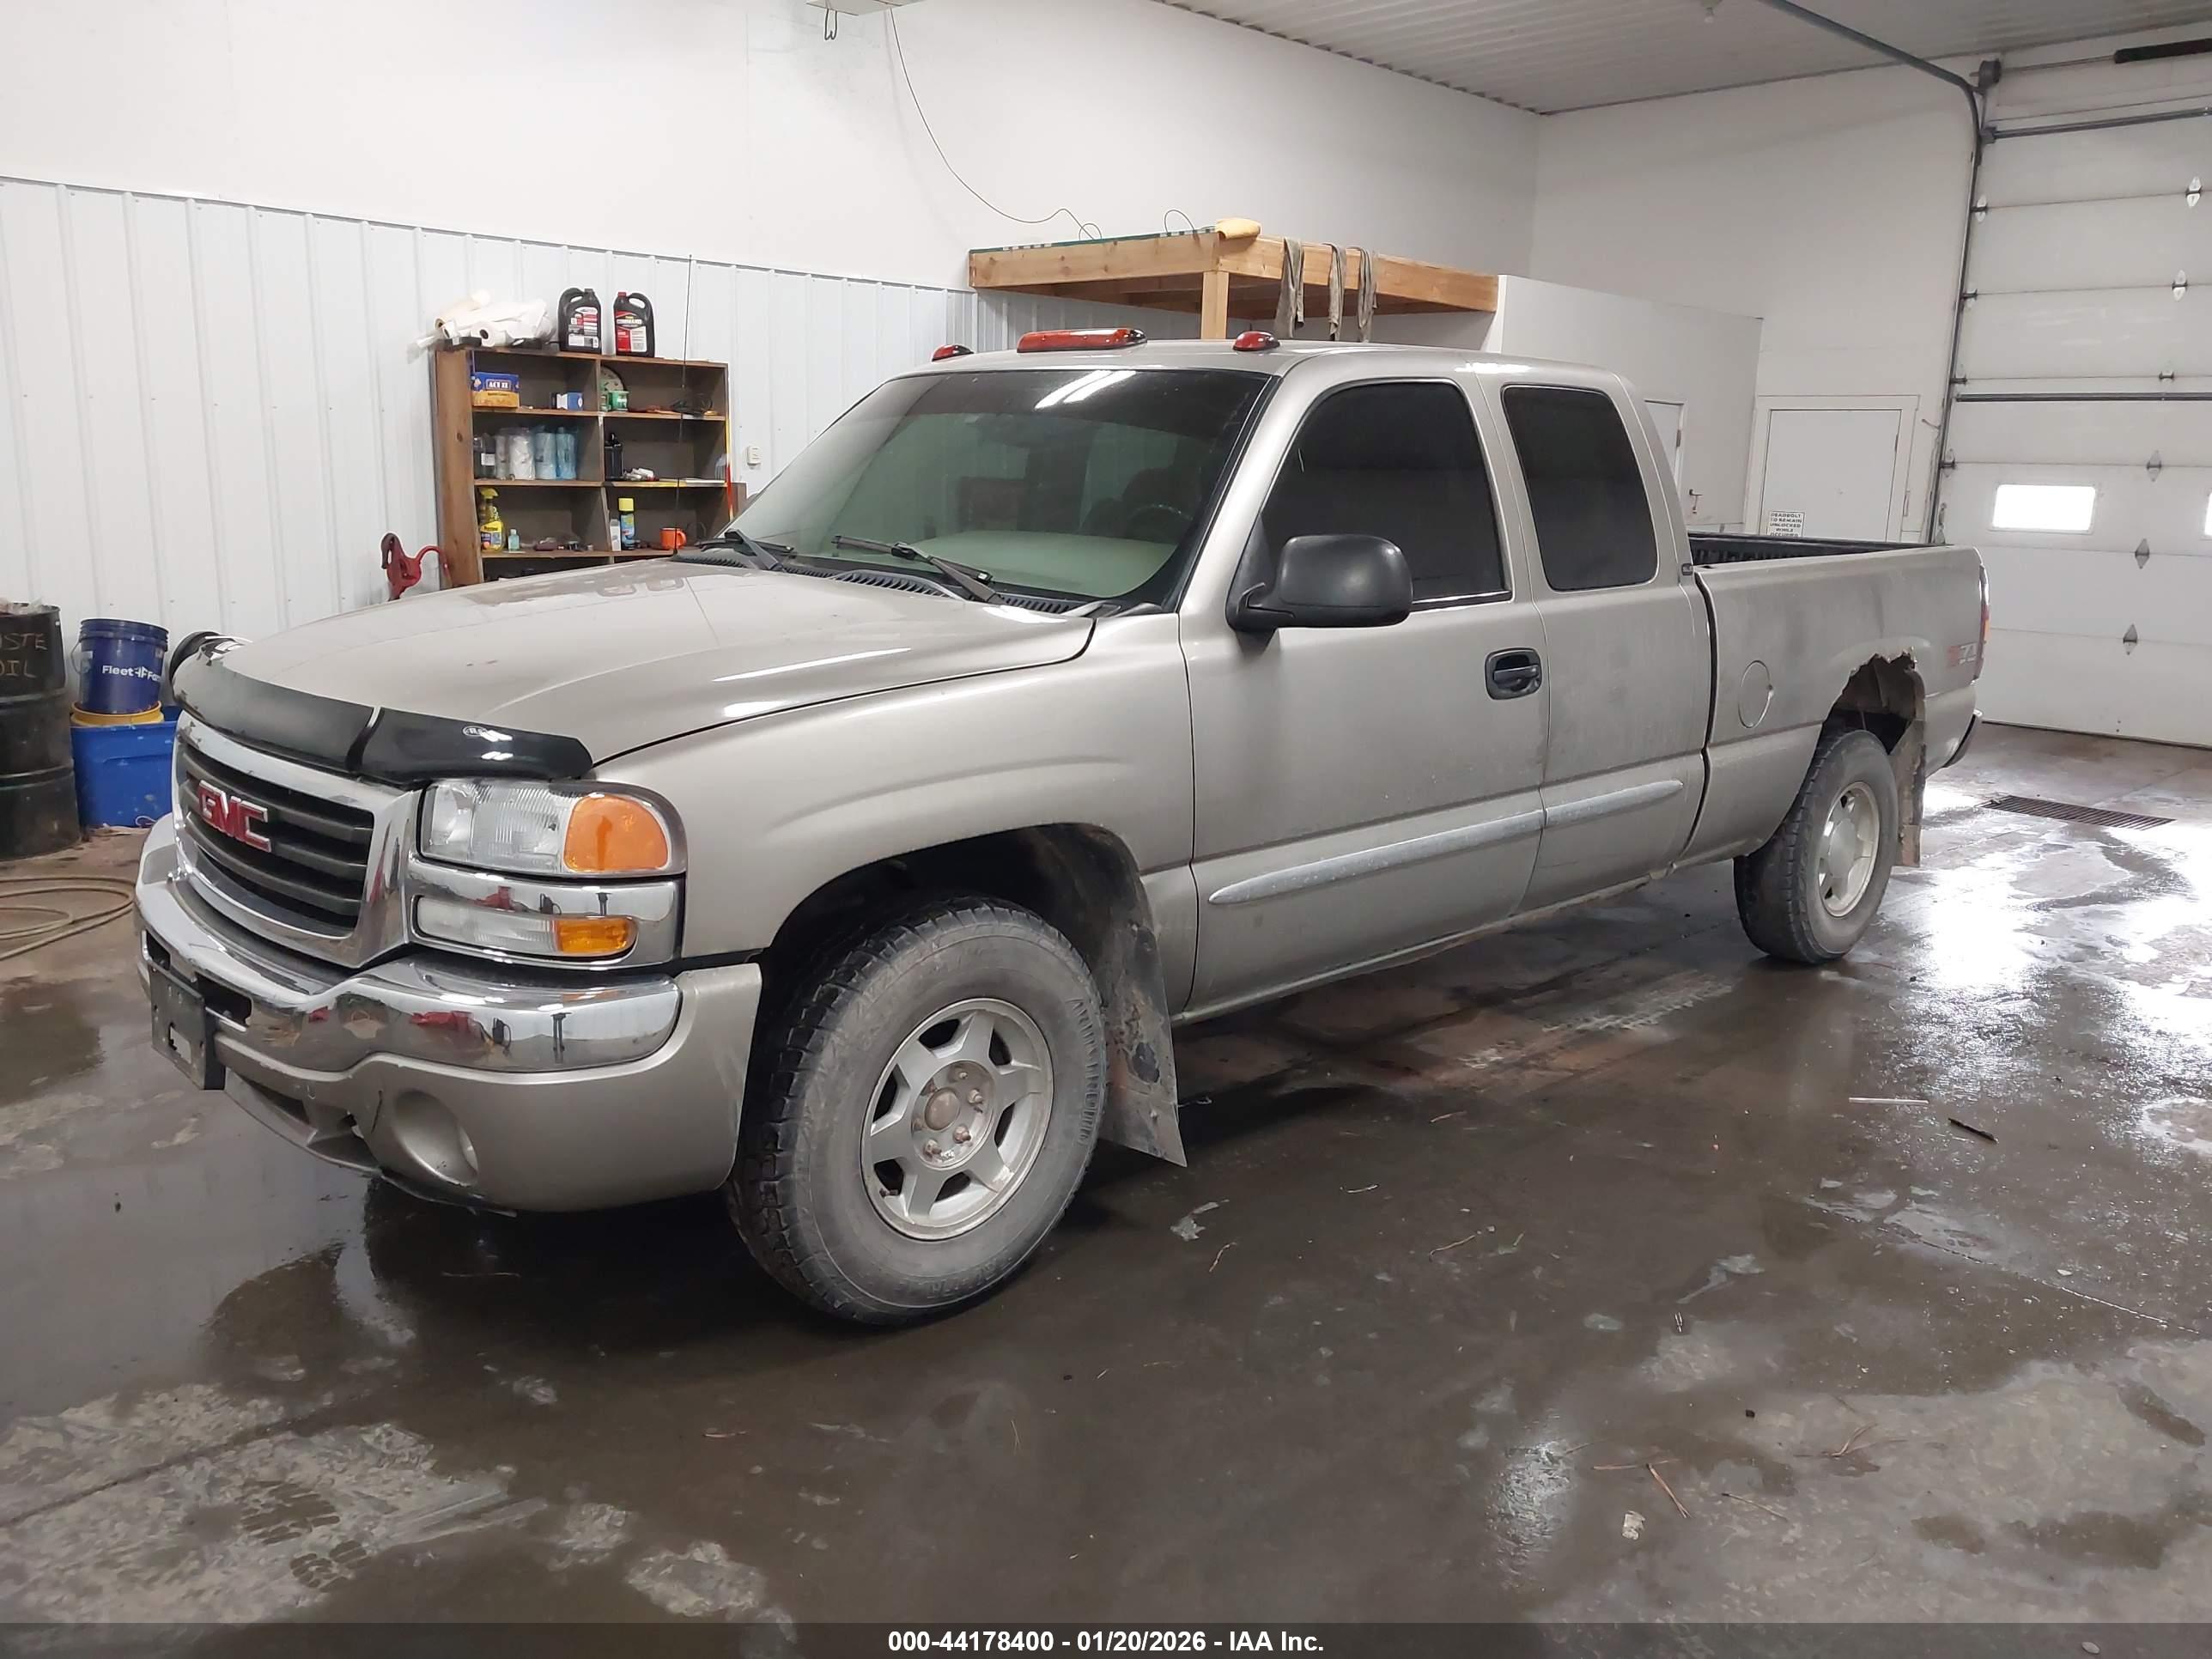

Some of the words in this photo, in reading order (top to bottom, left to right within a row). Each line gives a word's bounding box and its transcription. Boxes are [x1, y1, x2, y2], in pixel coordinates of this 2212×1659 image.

[0, 633, 47, 651] STE
[102, 665, 134, 677] Fleet
[198, 780, 271, 853] GMC
